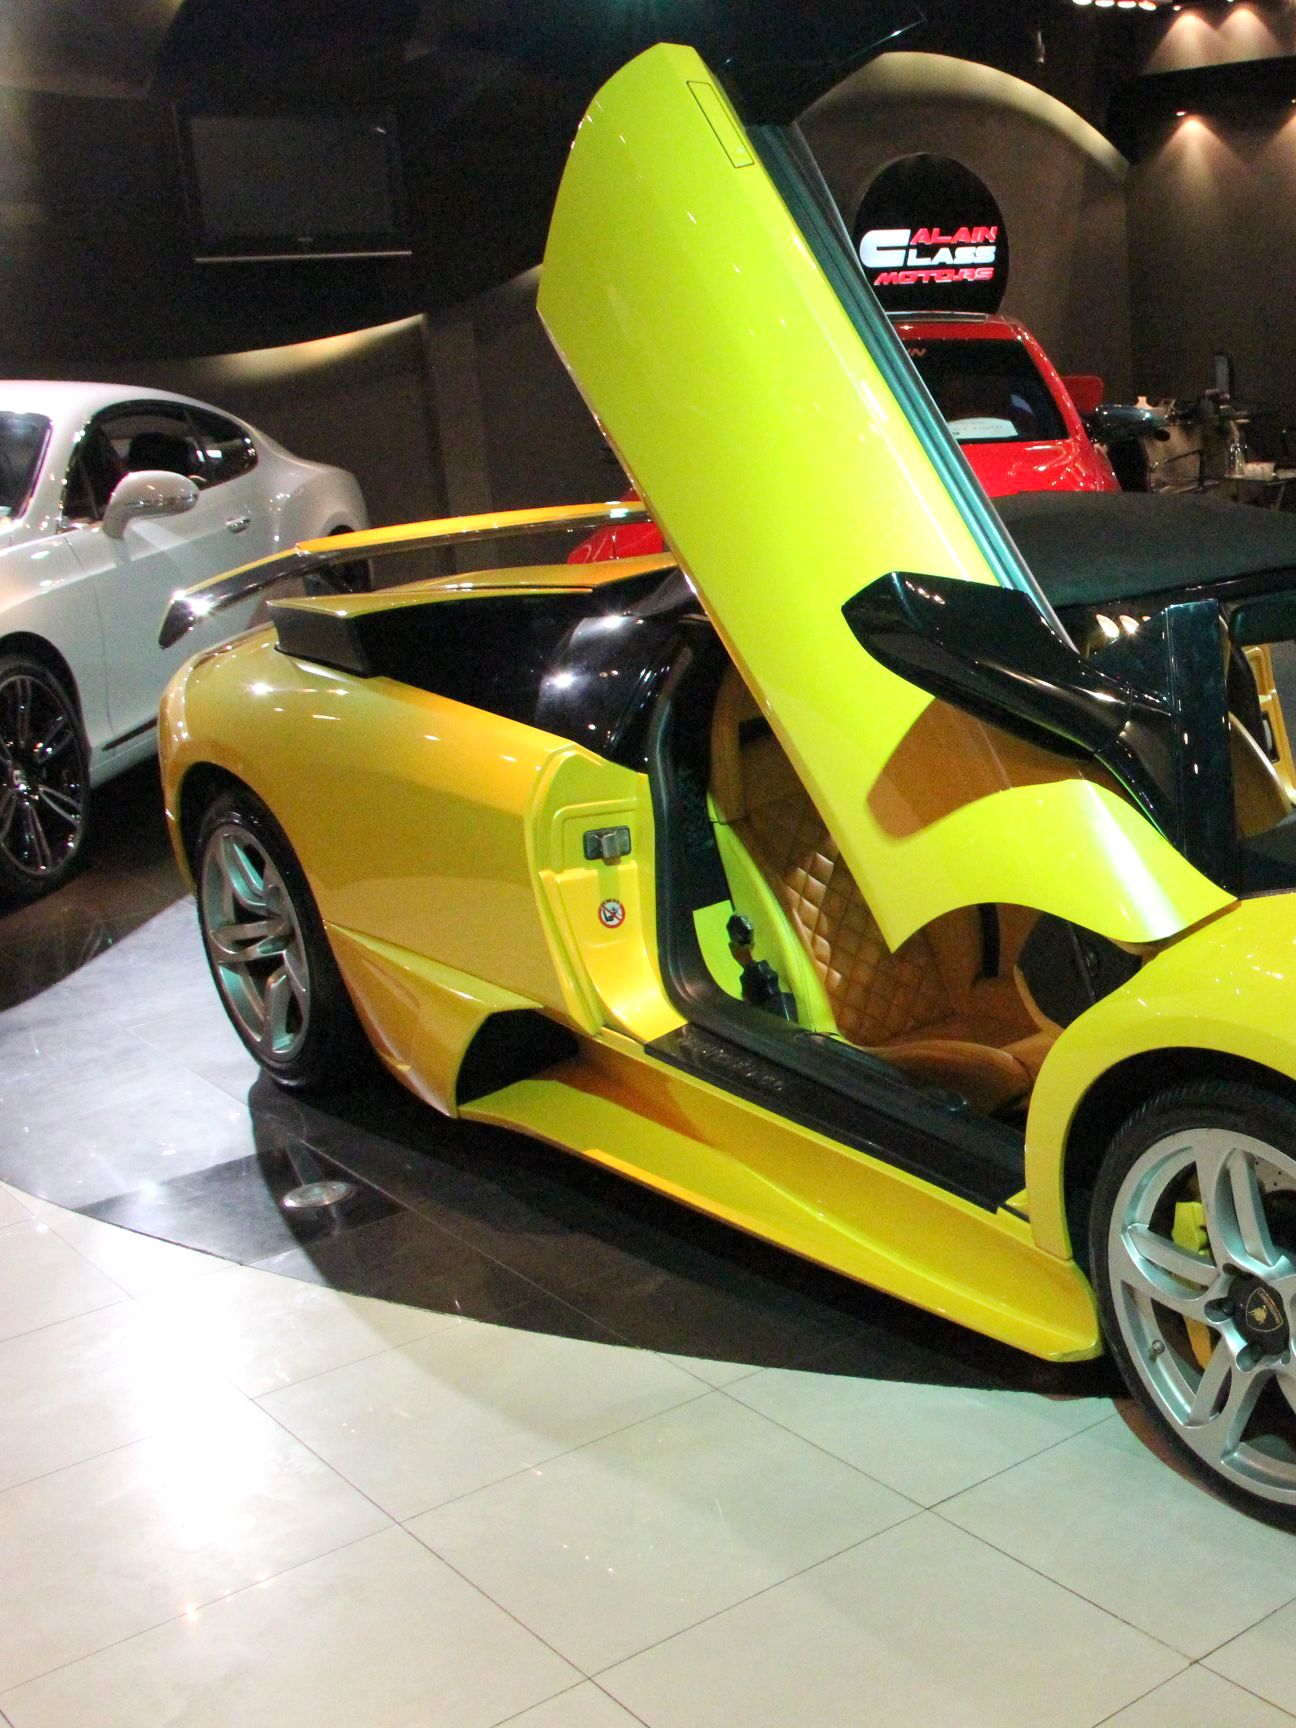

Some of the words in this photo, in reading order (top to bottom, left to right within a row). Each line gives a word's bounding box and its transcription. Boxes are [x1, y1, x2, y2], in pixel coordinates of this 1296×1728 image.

[910, 226, 998, 245] ALAIN
[859, 229, 996, 268] CLASS
[873, 267, 995, 285] MOTORS
